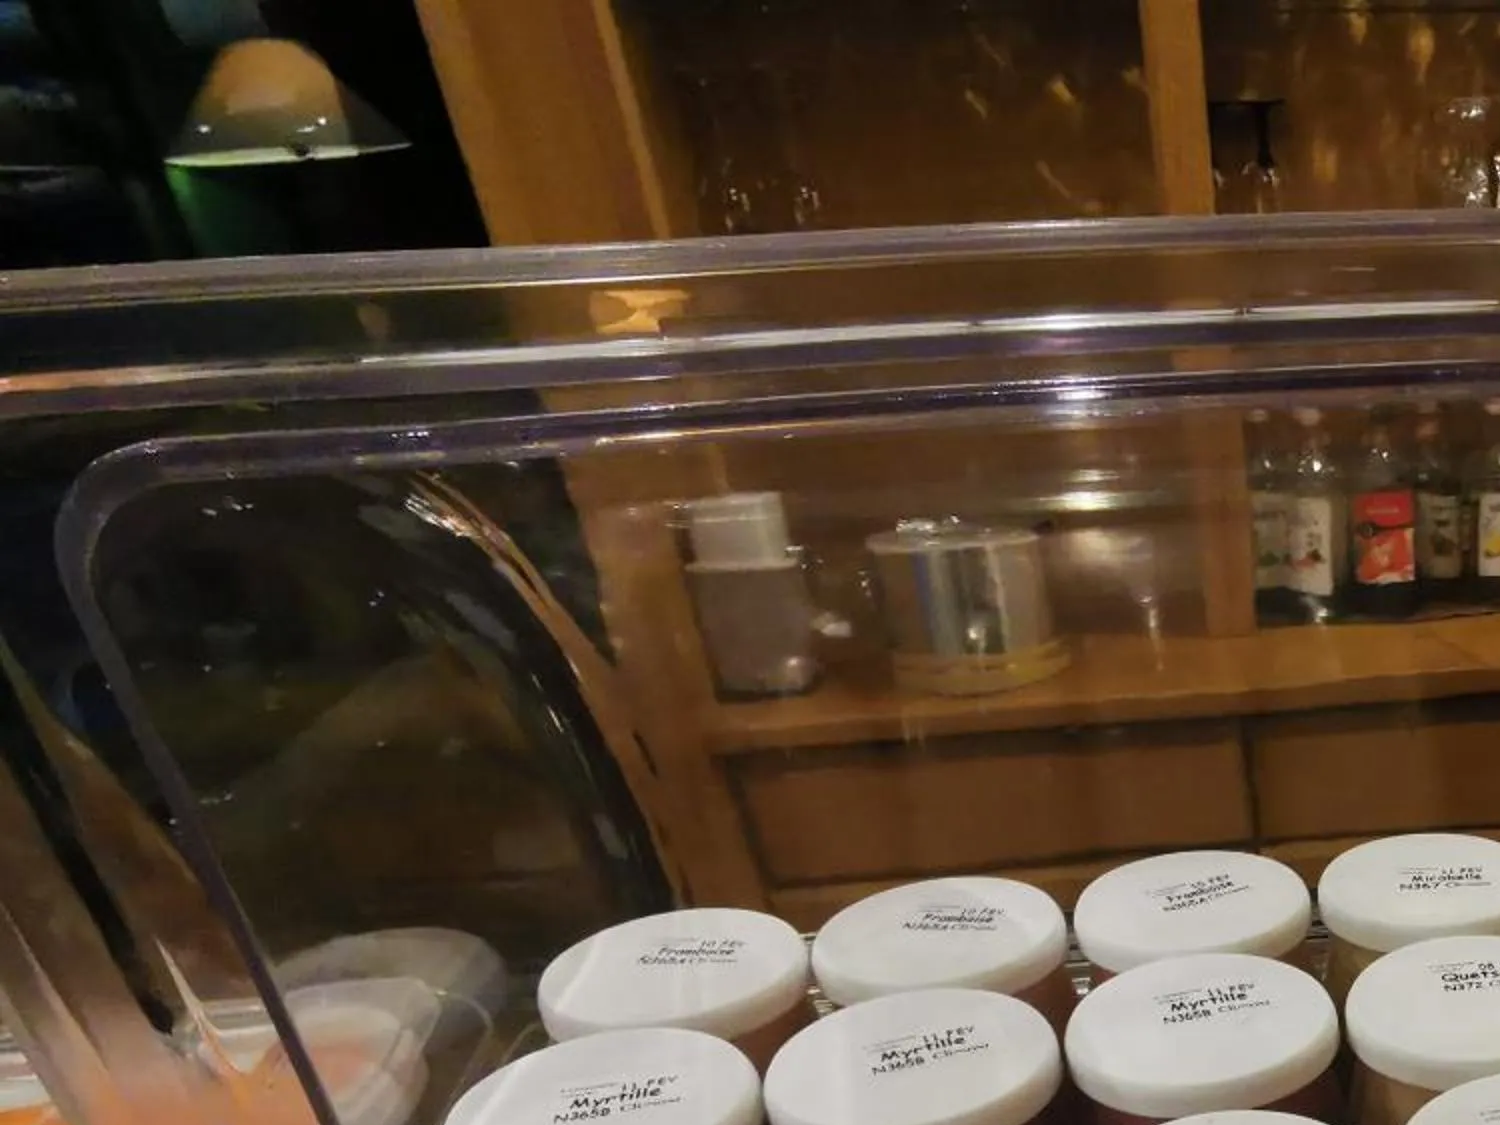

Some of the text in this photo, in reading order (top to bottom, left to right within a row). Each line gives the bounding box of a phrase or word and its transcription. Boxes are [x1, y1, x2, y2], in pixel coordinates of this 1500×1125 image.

[1171, 993, 1248, 1013] Myrtille
[880, 1036, 965, 1063] Myrtille
[569, 1086, 662, 1110] Myrtille
